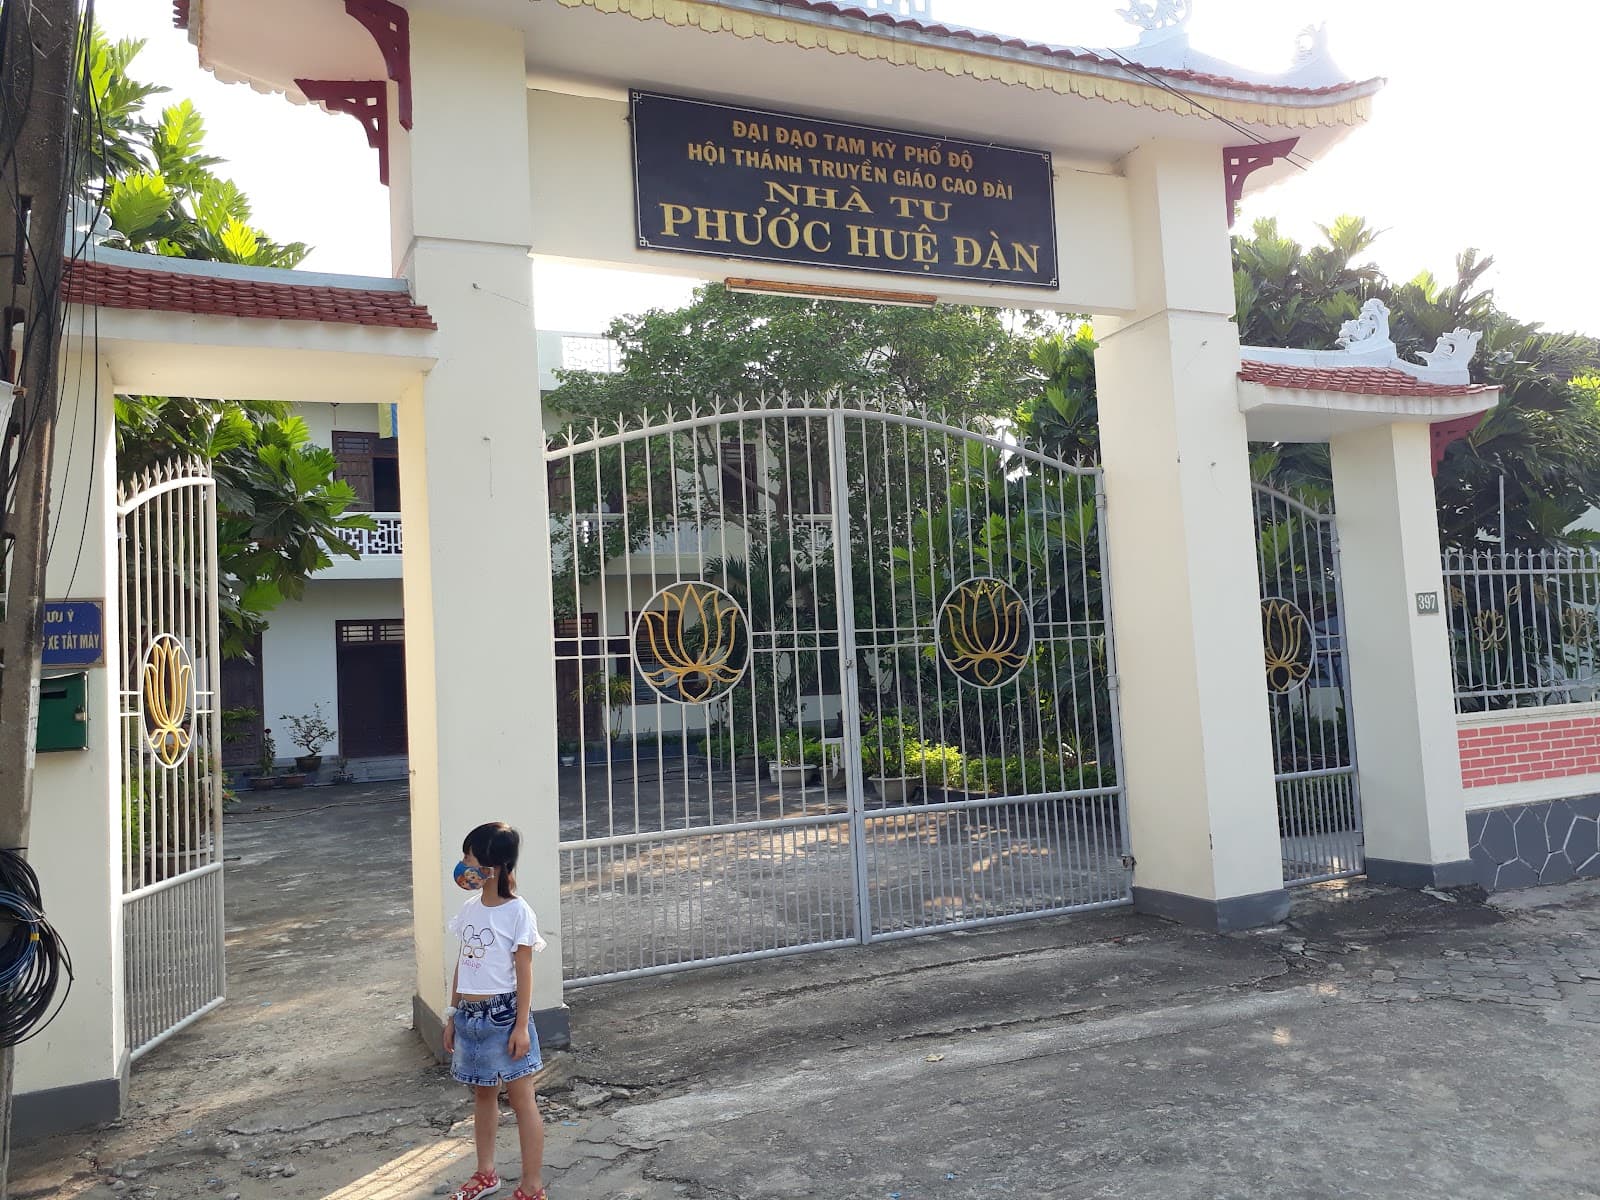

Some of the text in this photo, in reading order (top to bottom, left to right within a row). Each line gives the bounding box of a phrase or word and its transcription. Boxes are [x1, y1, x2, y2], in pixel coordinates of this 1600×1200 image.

[732, 119, 973, 173] ĐẠI ĐẠO TAM KỲ PHỔ ĐỘ
[687, 140, 1013, 201] HỘI THÁNH TRUYỀN GIÁO CAO ĐÀI
[764, 181, 952, 222] NHÀ TU
[659, 202, 1040, 274] PHƯỚC HUỆ ĐÀN
[43, 610, 64, 623] ƯU
[1419, 595, 1436, 609] 397
[48, 635, 59, 650] XE
